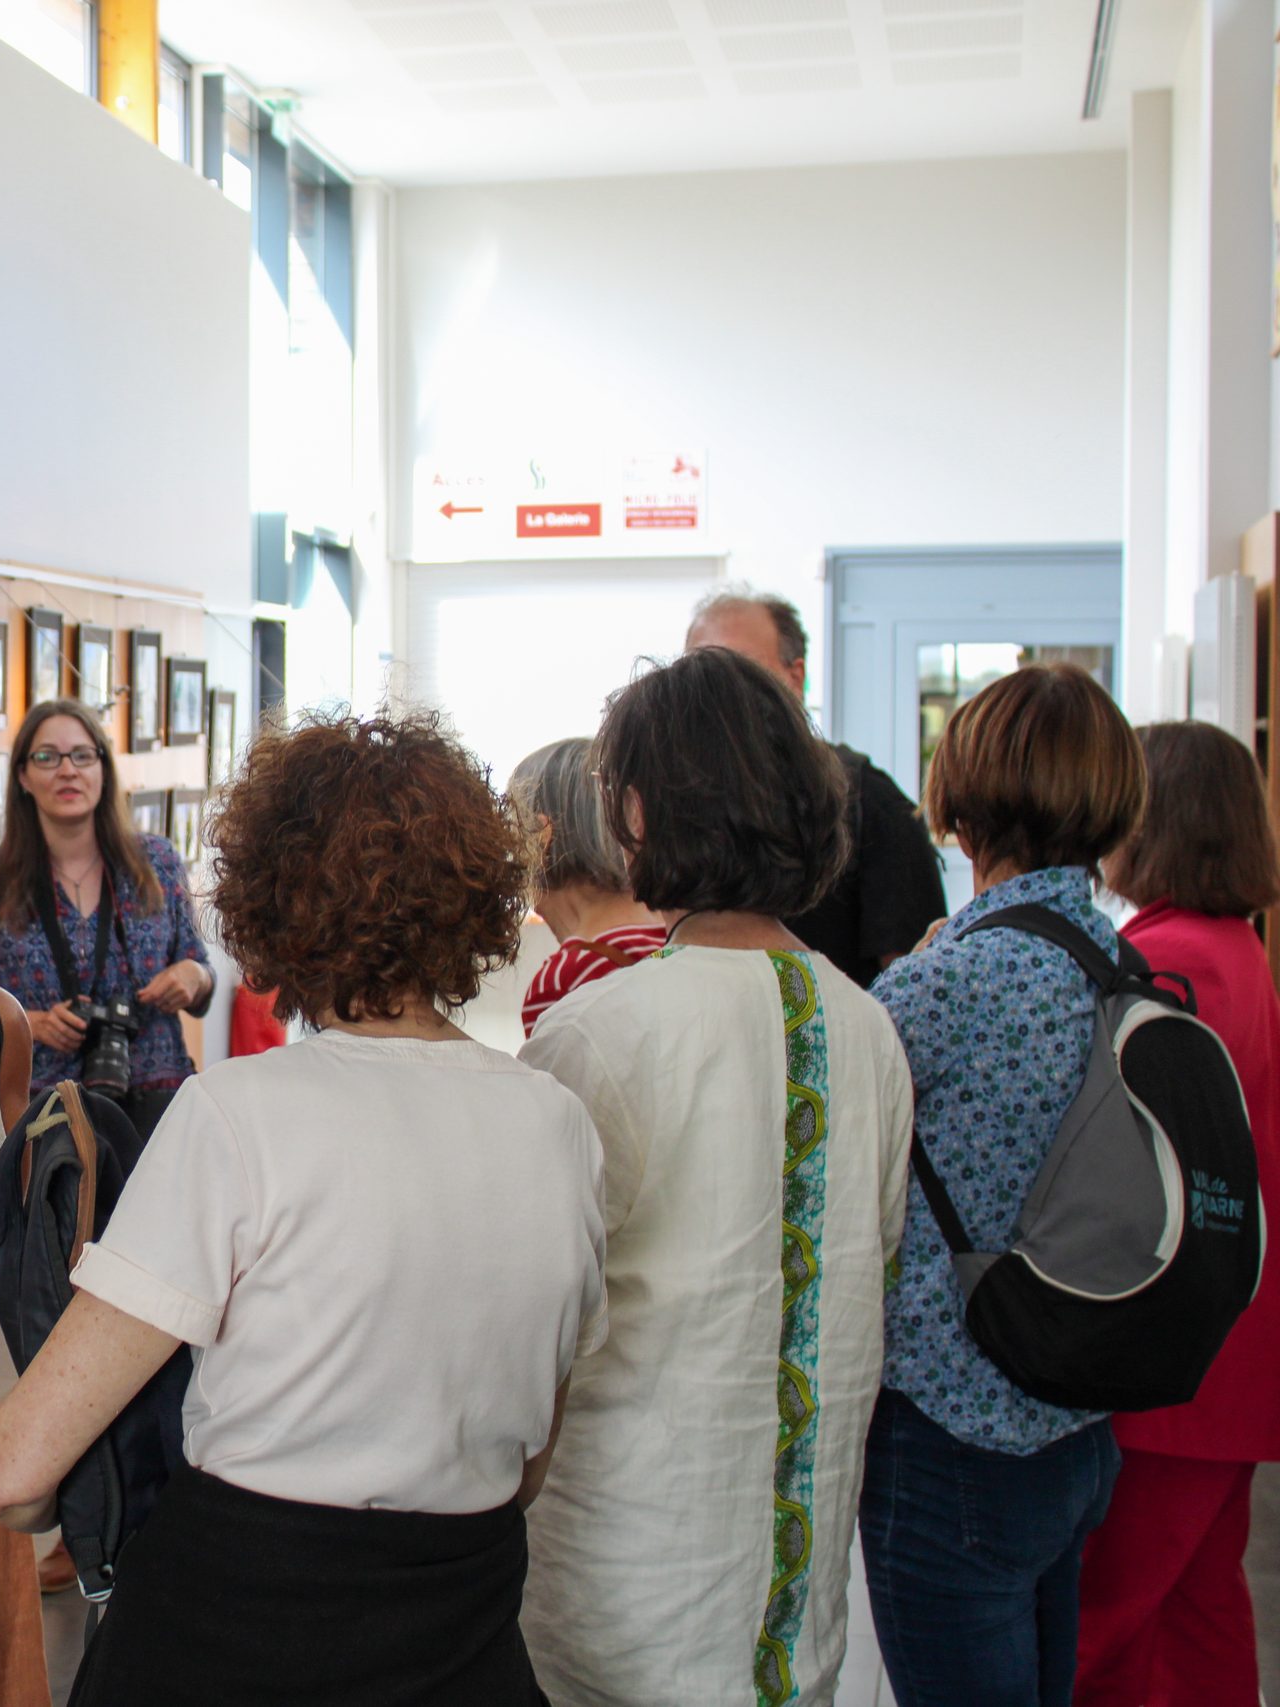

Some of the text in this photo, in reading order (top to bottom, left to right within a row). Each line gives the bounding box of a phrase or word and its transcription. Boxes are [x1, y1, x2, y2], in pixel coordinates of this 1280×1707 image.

[526, 511, 590, 527] La Galerie
[1210, 1176, 1229, 1194] de
